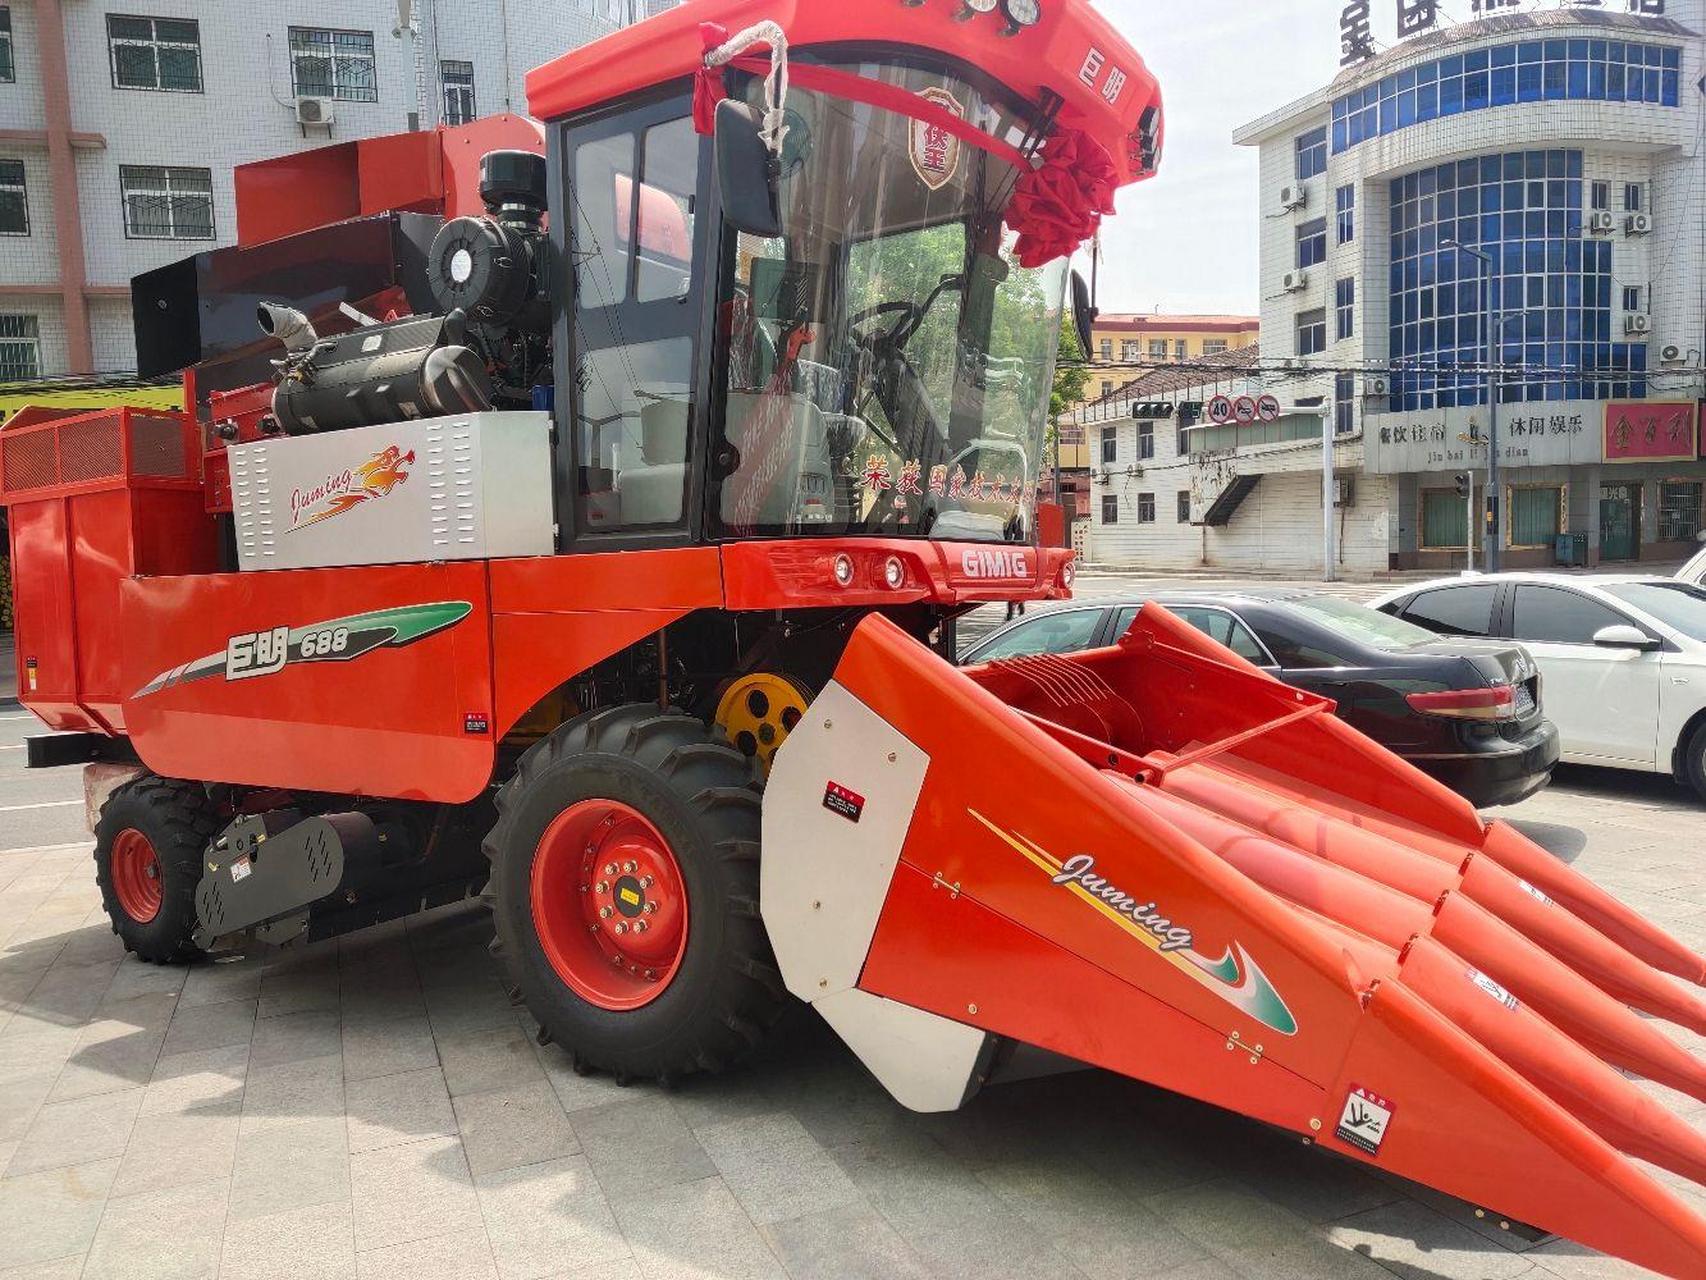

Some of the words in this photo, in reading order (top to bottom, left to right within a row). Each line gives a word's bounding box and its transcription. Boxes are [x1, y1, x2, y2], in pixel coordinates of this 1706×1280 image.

[1079, 47, 1127, 105] 巨明
[1213, 403, 1227, 416] 40
[1510, 414, 1583, 437] 休闲娱乐
[290, 468, 352, 525] Juming
[962, 550, 1027, 578] GIMIG
[226, 626, 289, 681] 巨明
[300, 627, 349, 658] 688
[1053, 854, 1193, 950] Juming
